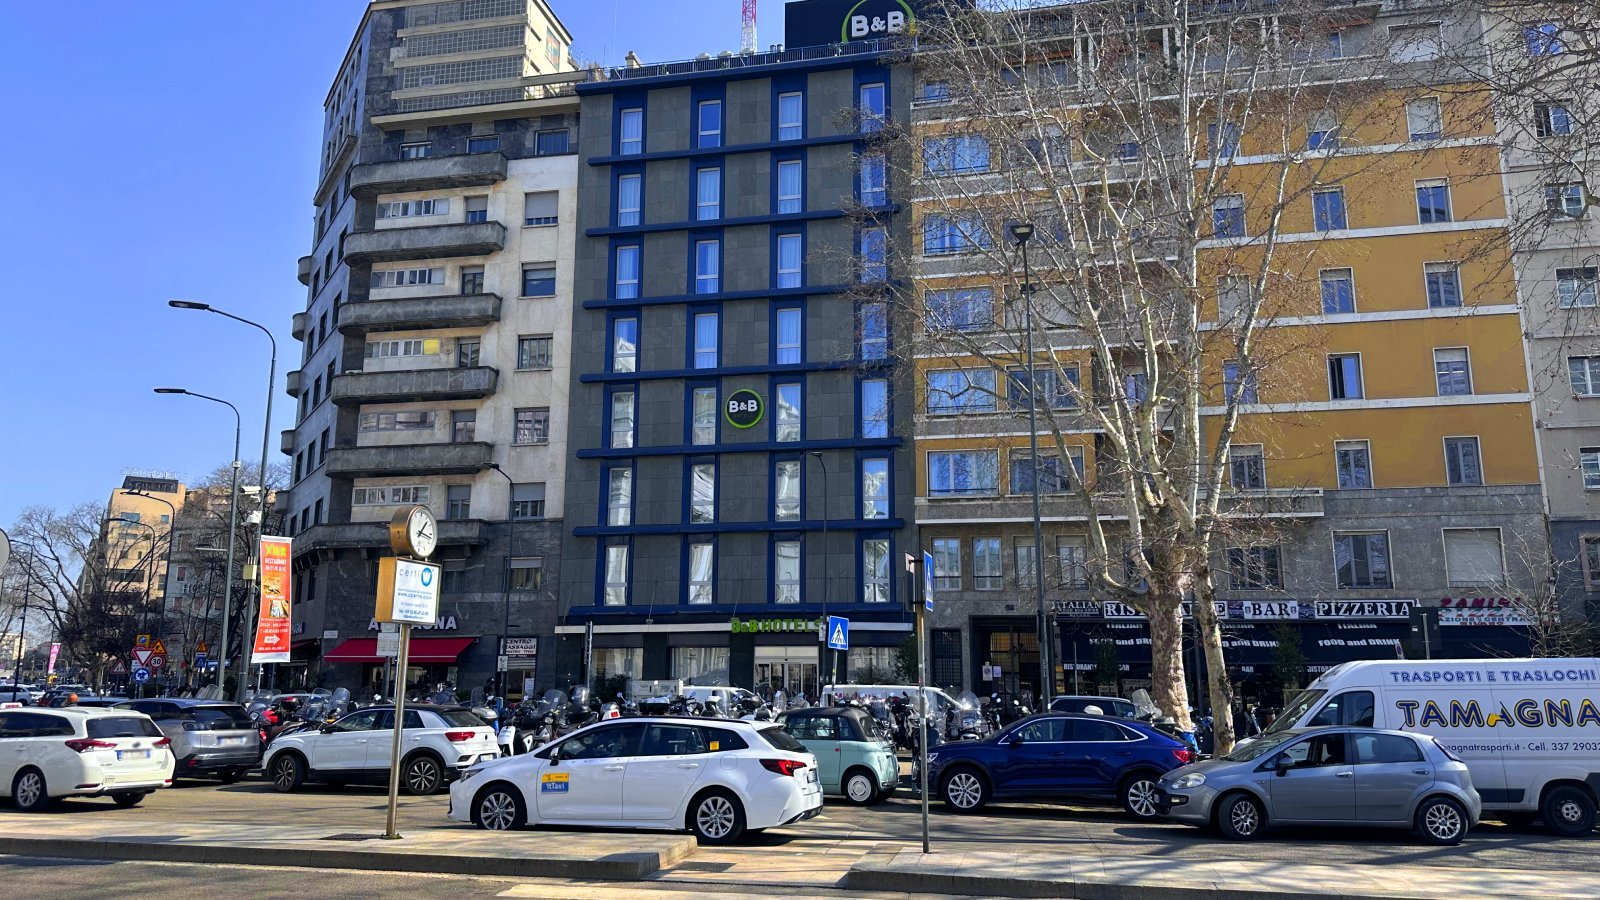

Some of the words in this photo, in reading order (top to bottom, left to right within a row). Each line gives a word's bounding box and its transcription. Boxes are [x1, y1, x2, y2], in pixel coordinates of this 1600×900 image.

[851, 10, 904, 37] B&B
[729, 399, 758, 413] B&B
[1106, 602, 1226, 617] RISAE
[1252, 602, 1290, 617] BAR
[1317, 602, 1410, 616] PIZZERIA
[731, 618, 758, 633] B&B
[761, 618, 821, 633] HOTELS
[1318, 638, 1346, 646] FOOD
[1368, 638, 1400, 646] DRINK
[152, 658, 161, 666] 30
[1390, 670, 1482, 683] TRASPORTI
[1486, 671, 1497, 682] E
[1500, 669, 1597, 682] TRASLOCHI
[1396, 699, 1600, 728] TAMAGNA
[1528, 742, 1549, 751] Cell.
[1551, 742, 1569, 751] 337
